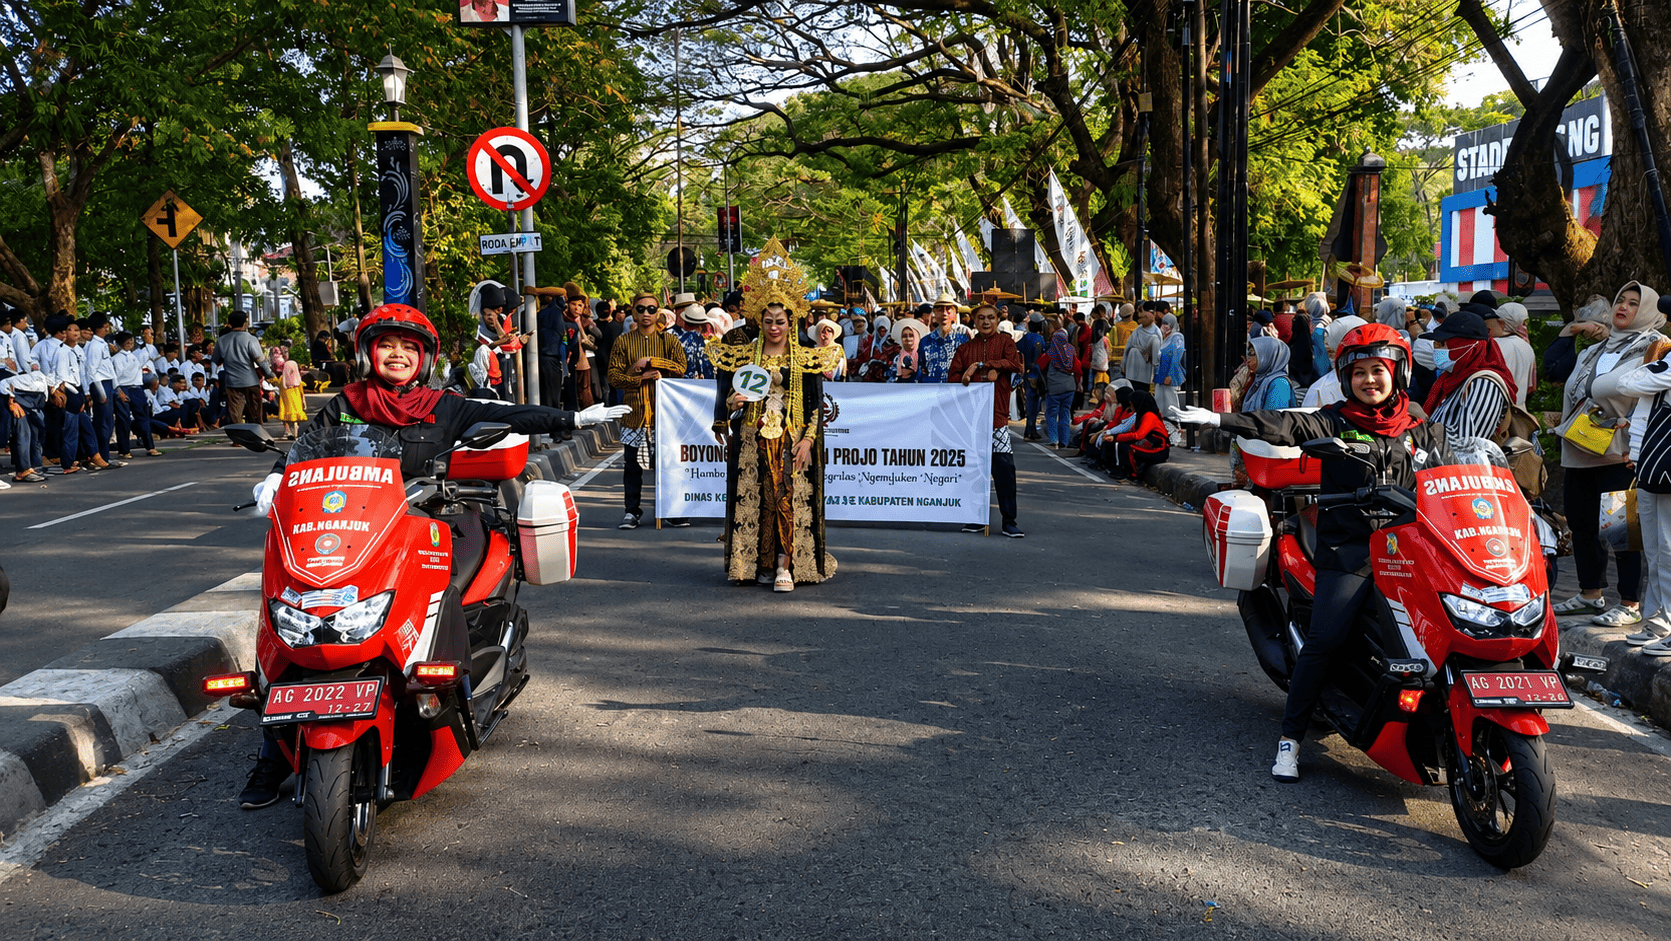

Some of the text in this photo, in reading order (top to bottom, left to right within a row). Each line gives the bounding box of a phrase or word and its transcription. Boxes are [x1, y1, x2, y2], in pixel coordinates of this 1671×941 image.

[481, 235, 541, 250] RODA EMPT
[739, 370, 767, 395] 12
[833, 447, 878, 466] PROJO
[881, 448, 926, 466] TAHUN
[930, 448, 966, 468] 2025
[684, 493, 712, 502] DINAS
[858, 496, 914, 506] KABUPATEN
[916, 497, 961, 507] NGANJUK
[1471, 676, 1557, 690] AG 2021 VP
[272, 683, 375, 704] AG 2022 VP
[327, 702, 371, 714] 12-27
